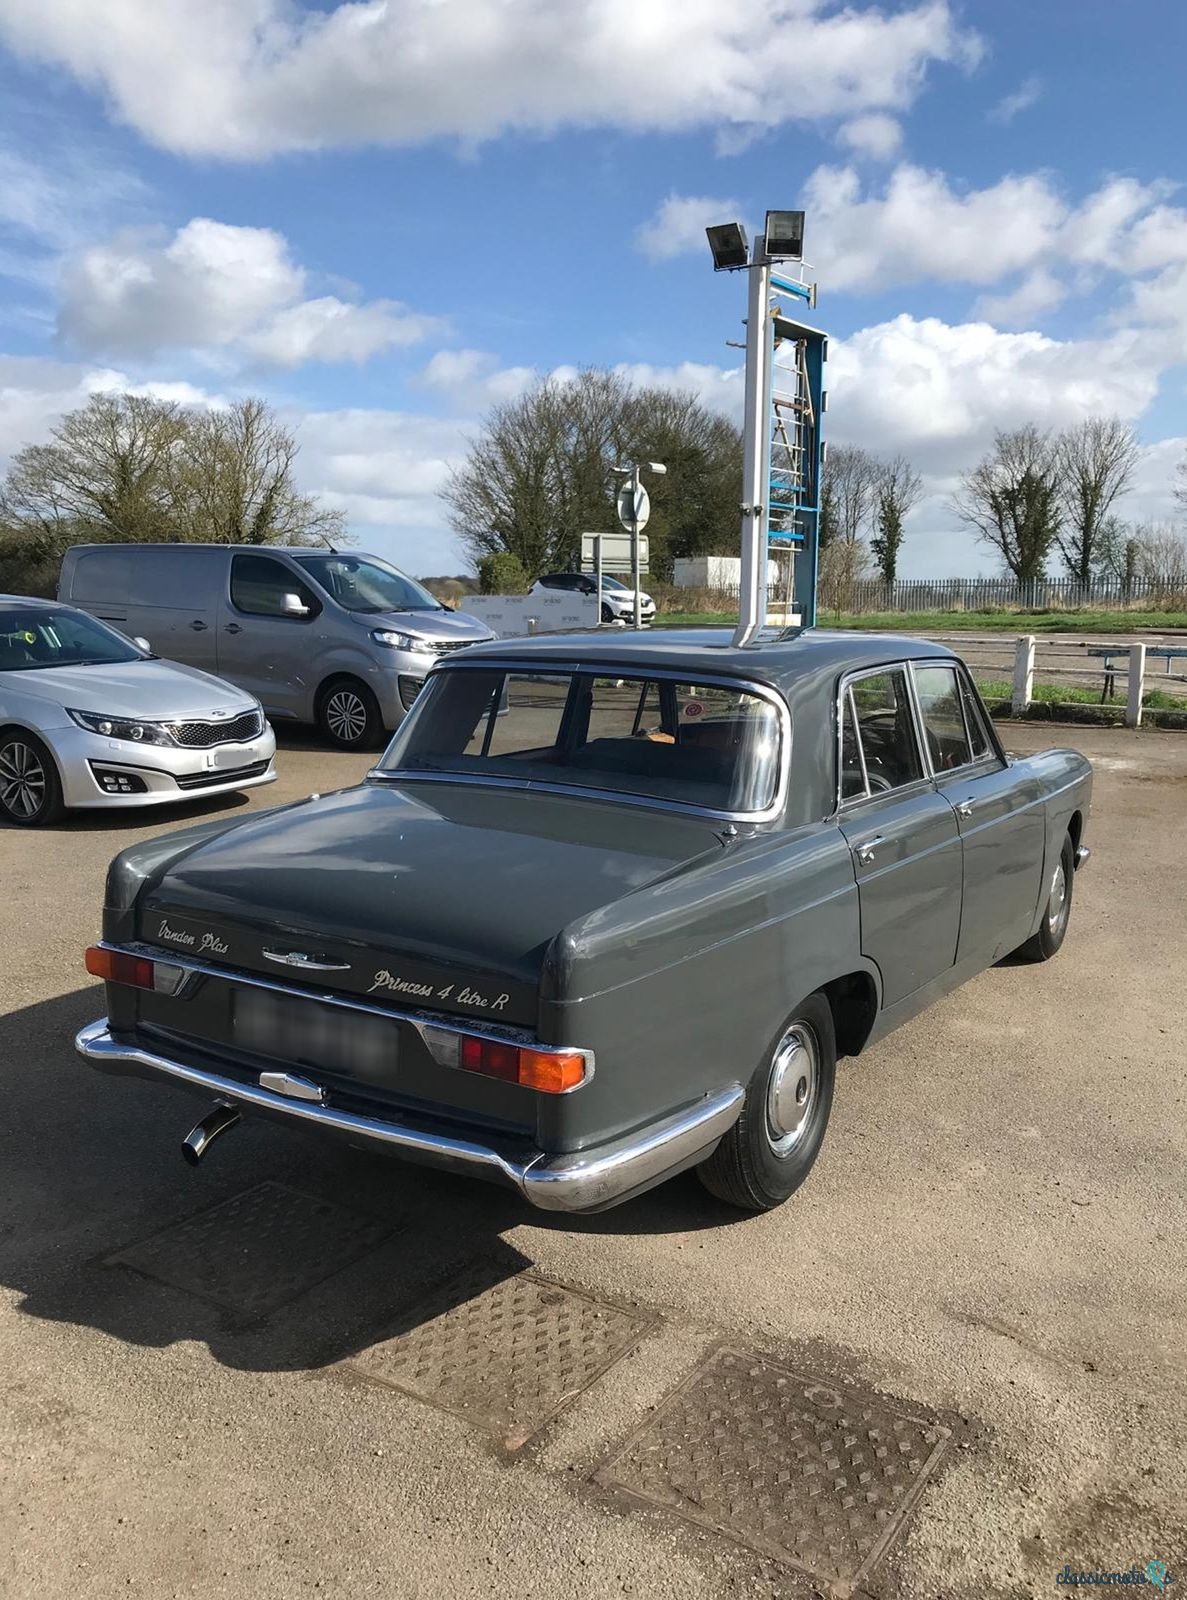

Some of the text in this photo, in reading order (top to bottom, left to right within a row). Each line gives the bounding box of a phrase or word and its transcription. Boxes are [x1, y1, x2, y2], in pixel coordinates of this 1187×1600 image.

[158, 919, 229, 953] Vanden Plas
[367, 969, 510, 1010] Princess 4 litre R
